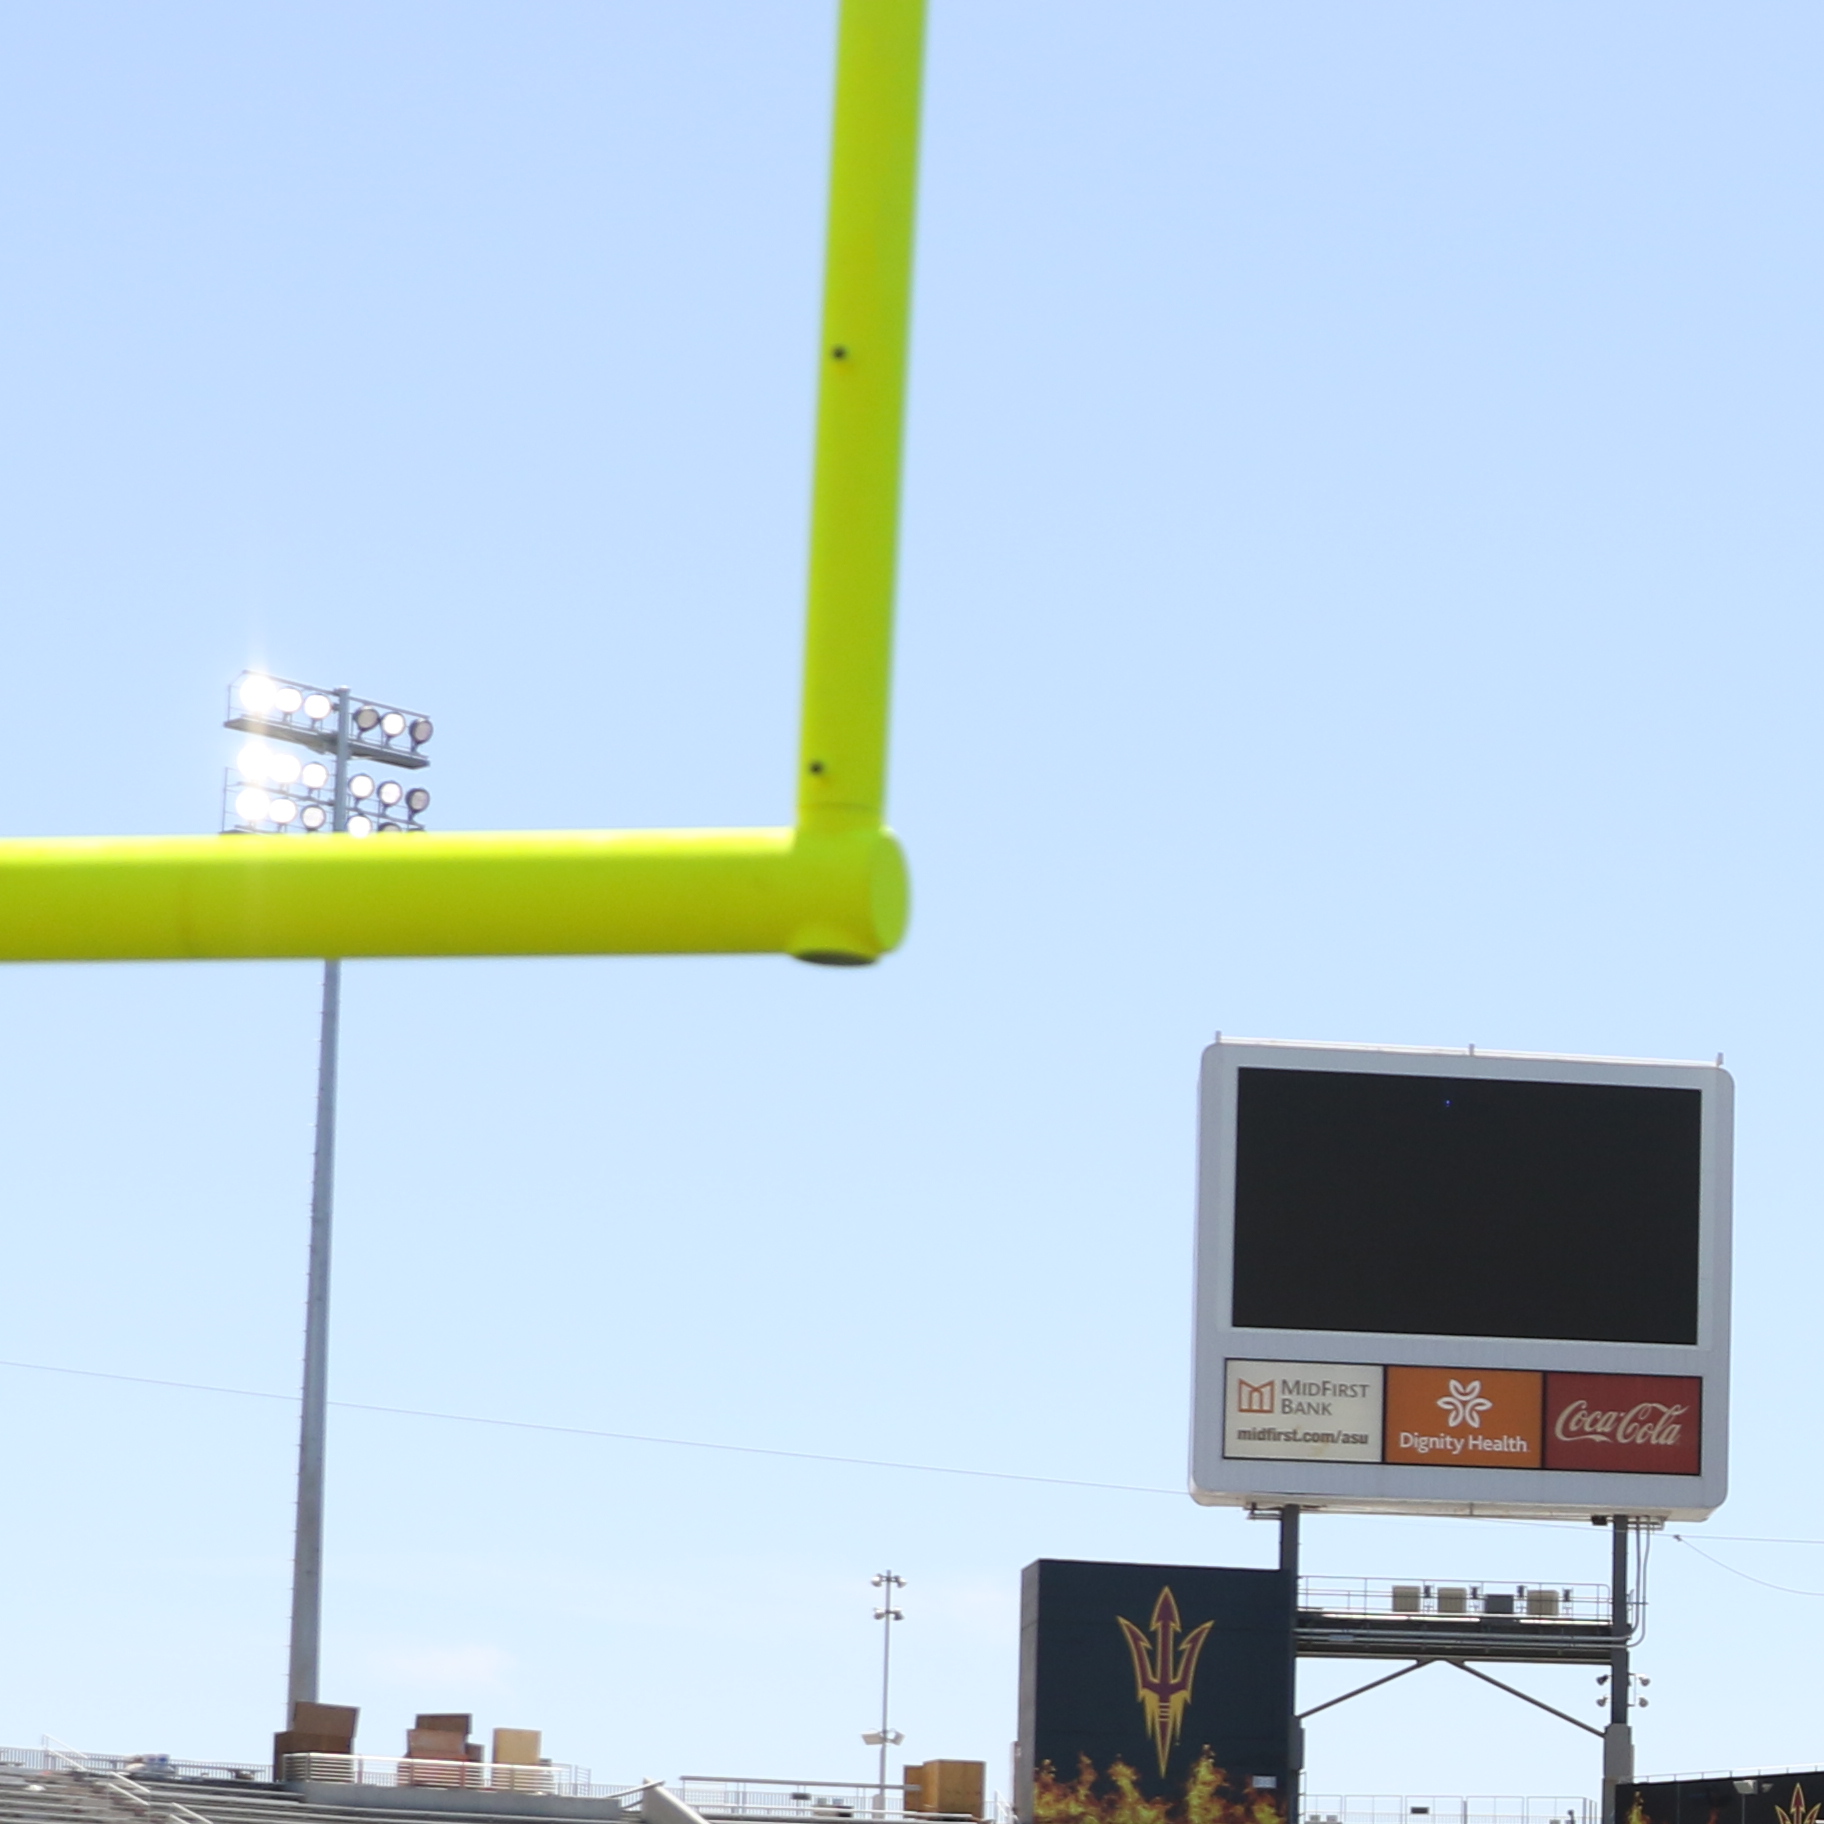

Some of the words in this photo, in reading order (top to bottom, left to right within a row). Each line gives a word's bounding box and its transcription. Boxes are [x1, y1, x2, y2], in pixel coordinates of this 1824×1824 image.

[1555, 1400, 1690, 1445] Coca-Cola
[1237, 1427, 1369, 1445] midfirst.com/asu
[1400, 1432, 1464, 1454] Dignity
[1468, 1436, 1528, 1452] Health
